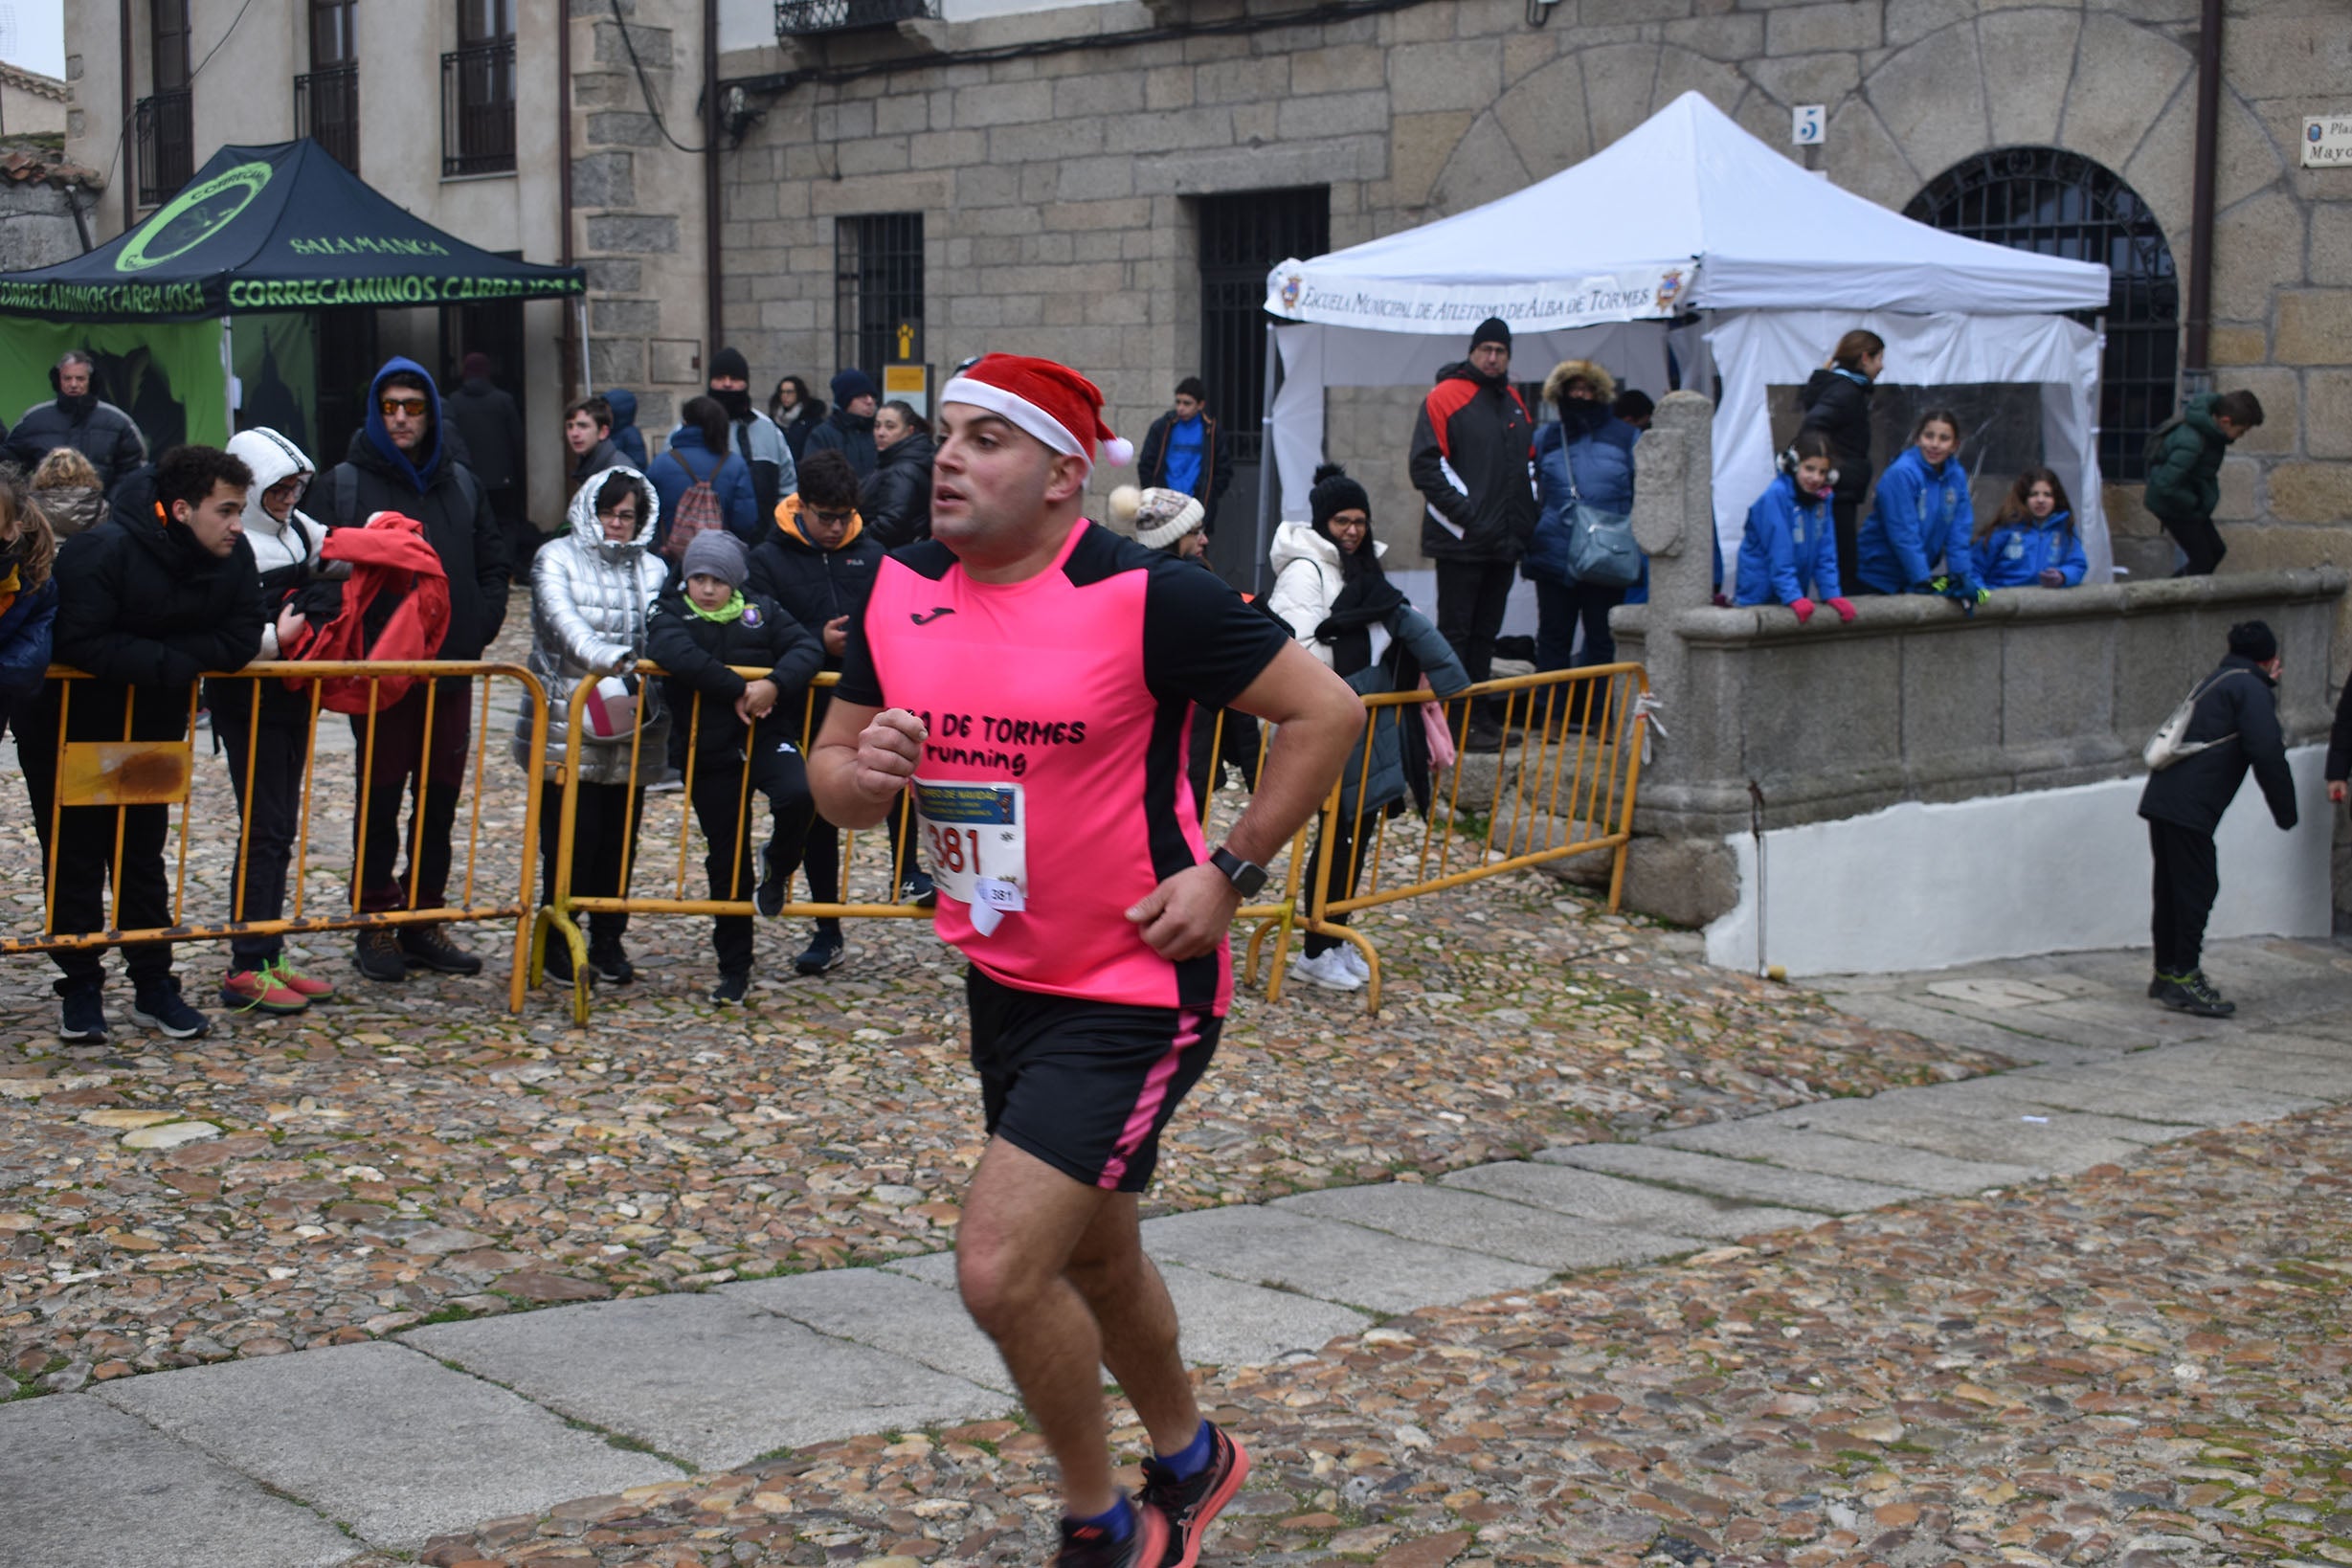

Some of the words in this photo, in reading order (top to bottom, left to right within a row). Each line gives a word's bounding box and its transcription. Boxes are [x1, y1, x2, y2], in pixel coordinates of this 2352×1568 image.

[1800, 108, 1818, 141] 5
[2329, 122, 2352, 135] Pla
[289, 235, 449, 256] SALAMANCA
[0, 281, 108, 313] ORRECAMINOS
[109, 280, 206, 314] CARBAJOSA
[229, 275, 438, 307] CORRECAMINOS
[1301, 286, 1351, 312] ESCUELA
[1352, 293, 1414, 318] MUNICIPAL
[1416, 303, 1432, 318] DE
[1504, 303, 1524, 320] DE
[1525, 297, 1563, 319] ALBA
[1567, 296, 1585, 314] DE
[1587, 289, 1650, 311] TORMES
[942, 713, 973, 738] DE
[982, 715, 1086, 745] TORMES
[926, 743, 1027, 776] running
[927, 823, 981, 875] 381
